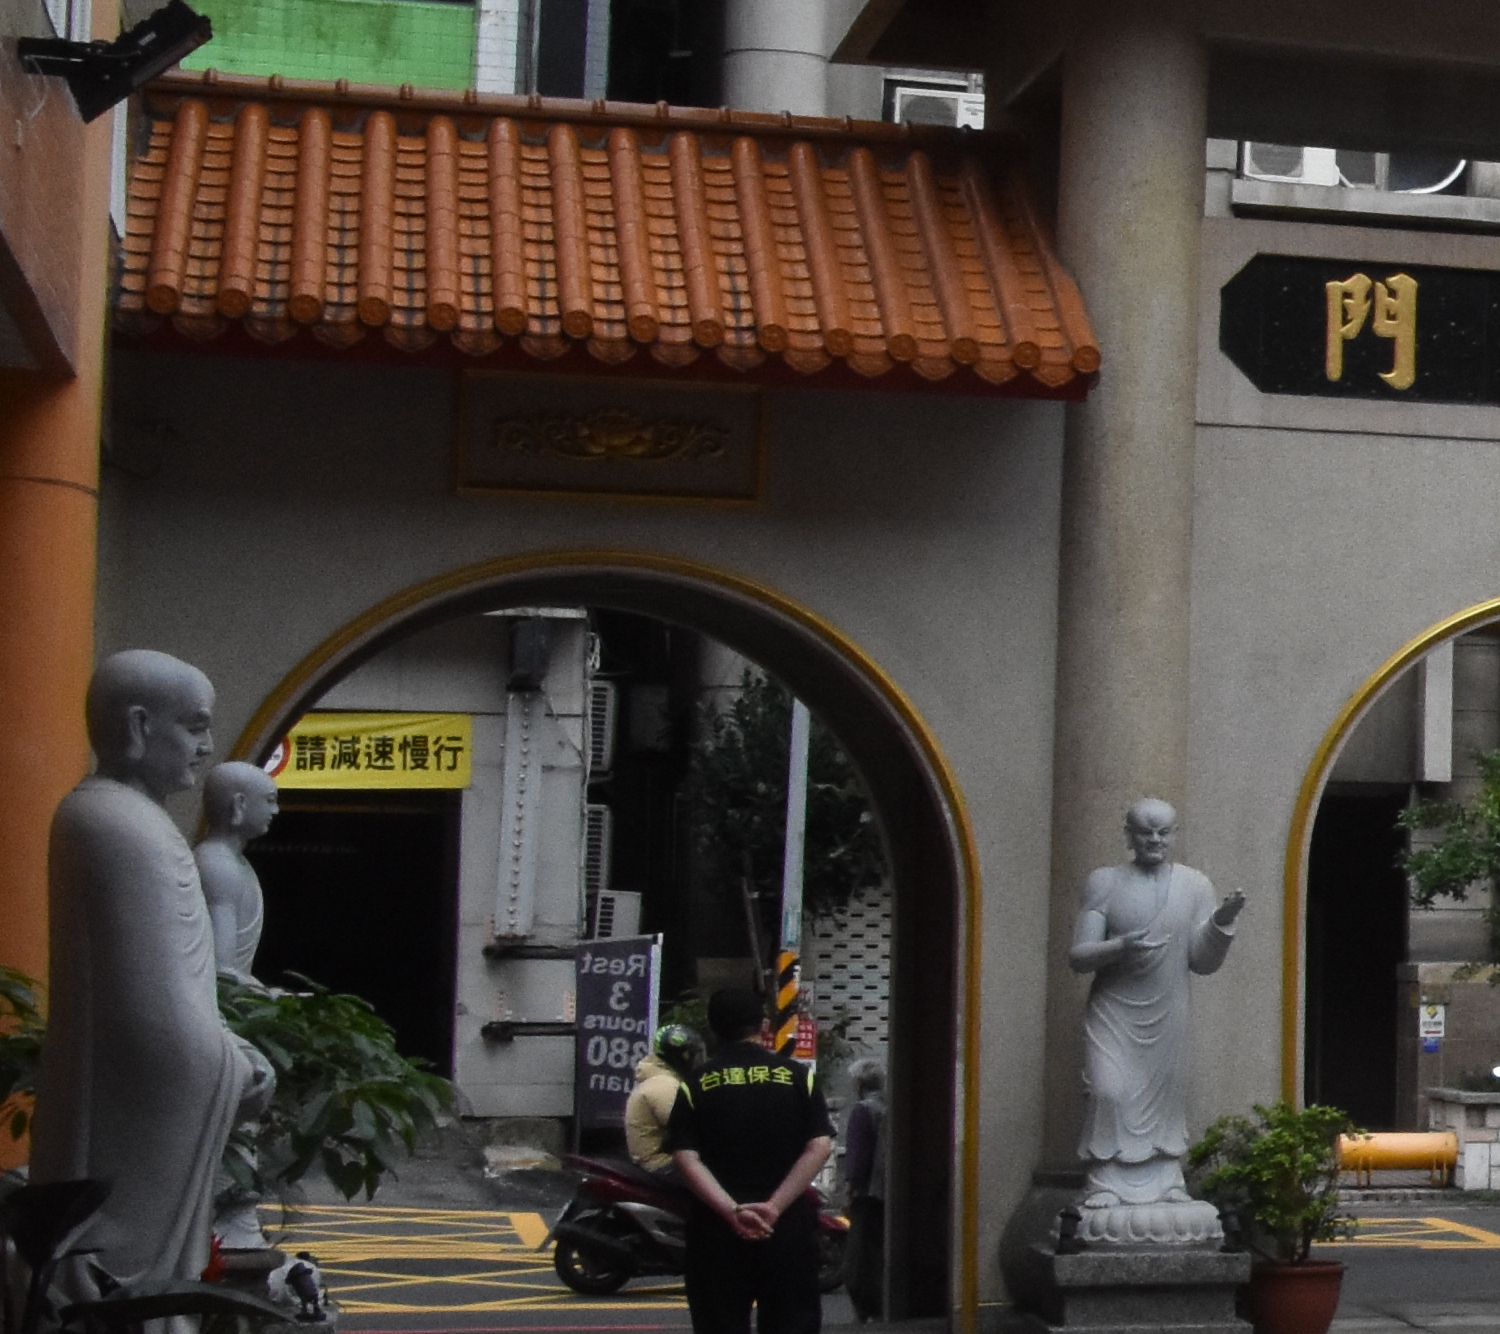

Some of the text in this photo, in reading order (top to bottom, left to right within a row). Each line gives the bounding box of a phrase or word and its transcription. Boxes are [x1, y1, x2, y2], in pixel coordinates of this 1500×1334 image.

[294, 735, 464, 771] 請減速慢行
